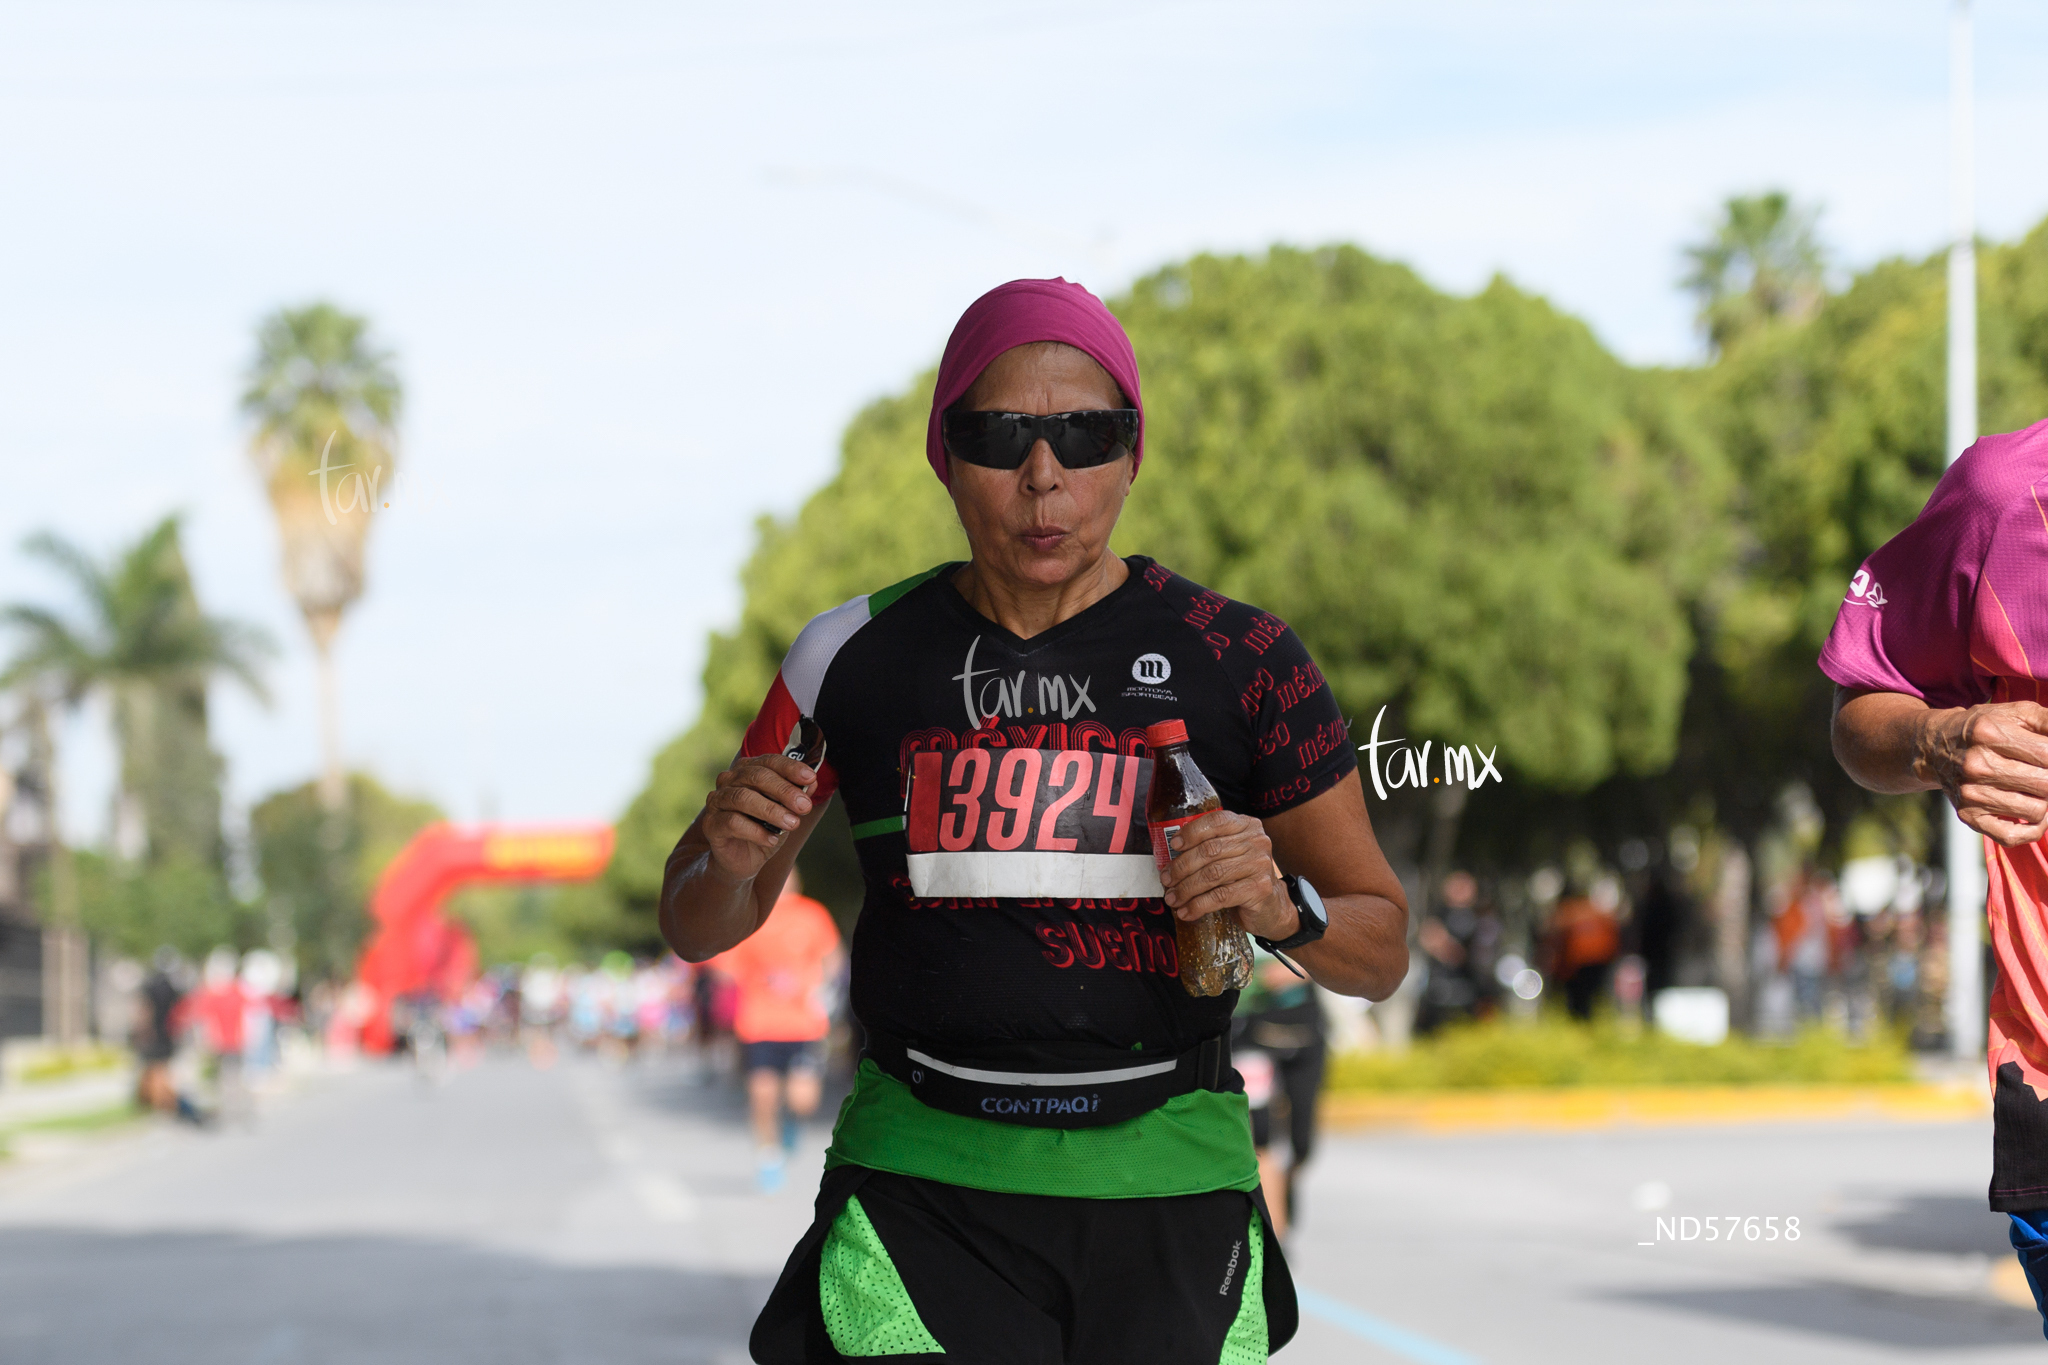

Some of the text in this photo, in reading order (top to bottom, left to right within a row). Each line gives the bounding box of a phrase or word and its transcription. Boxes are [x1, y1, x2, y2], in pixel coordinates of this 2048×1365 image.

[788, 751, 806, 762] GU
[939, 748, 1140, 854] 3924
[1219, 1239, 1243, 1296] Reebok
